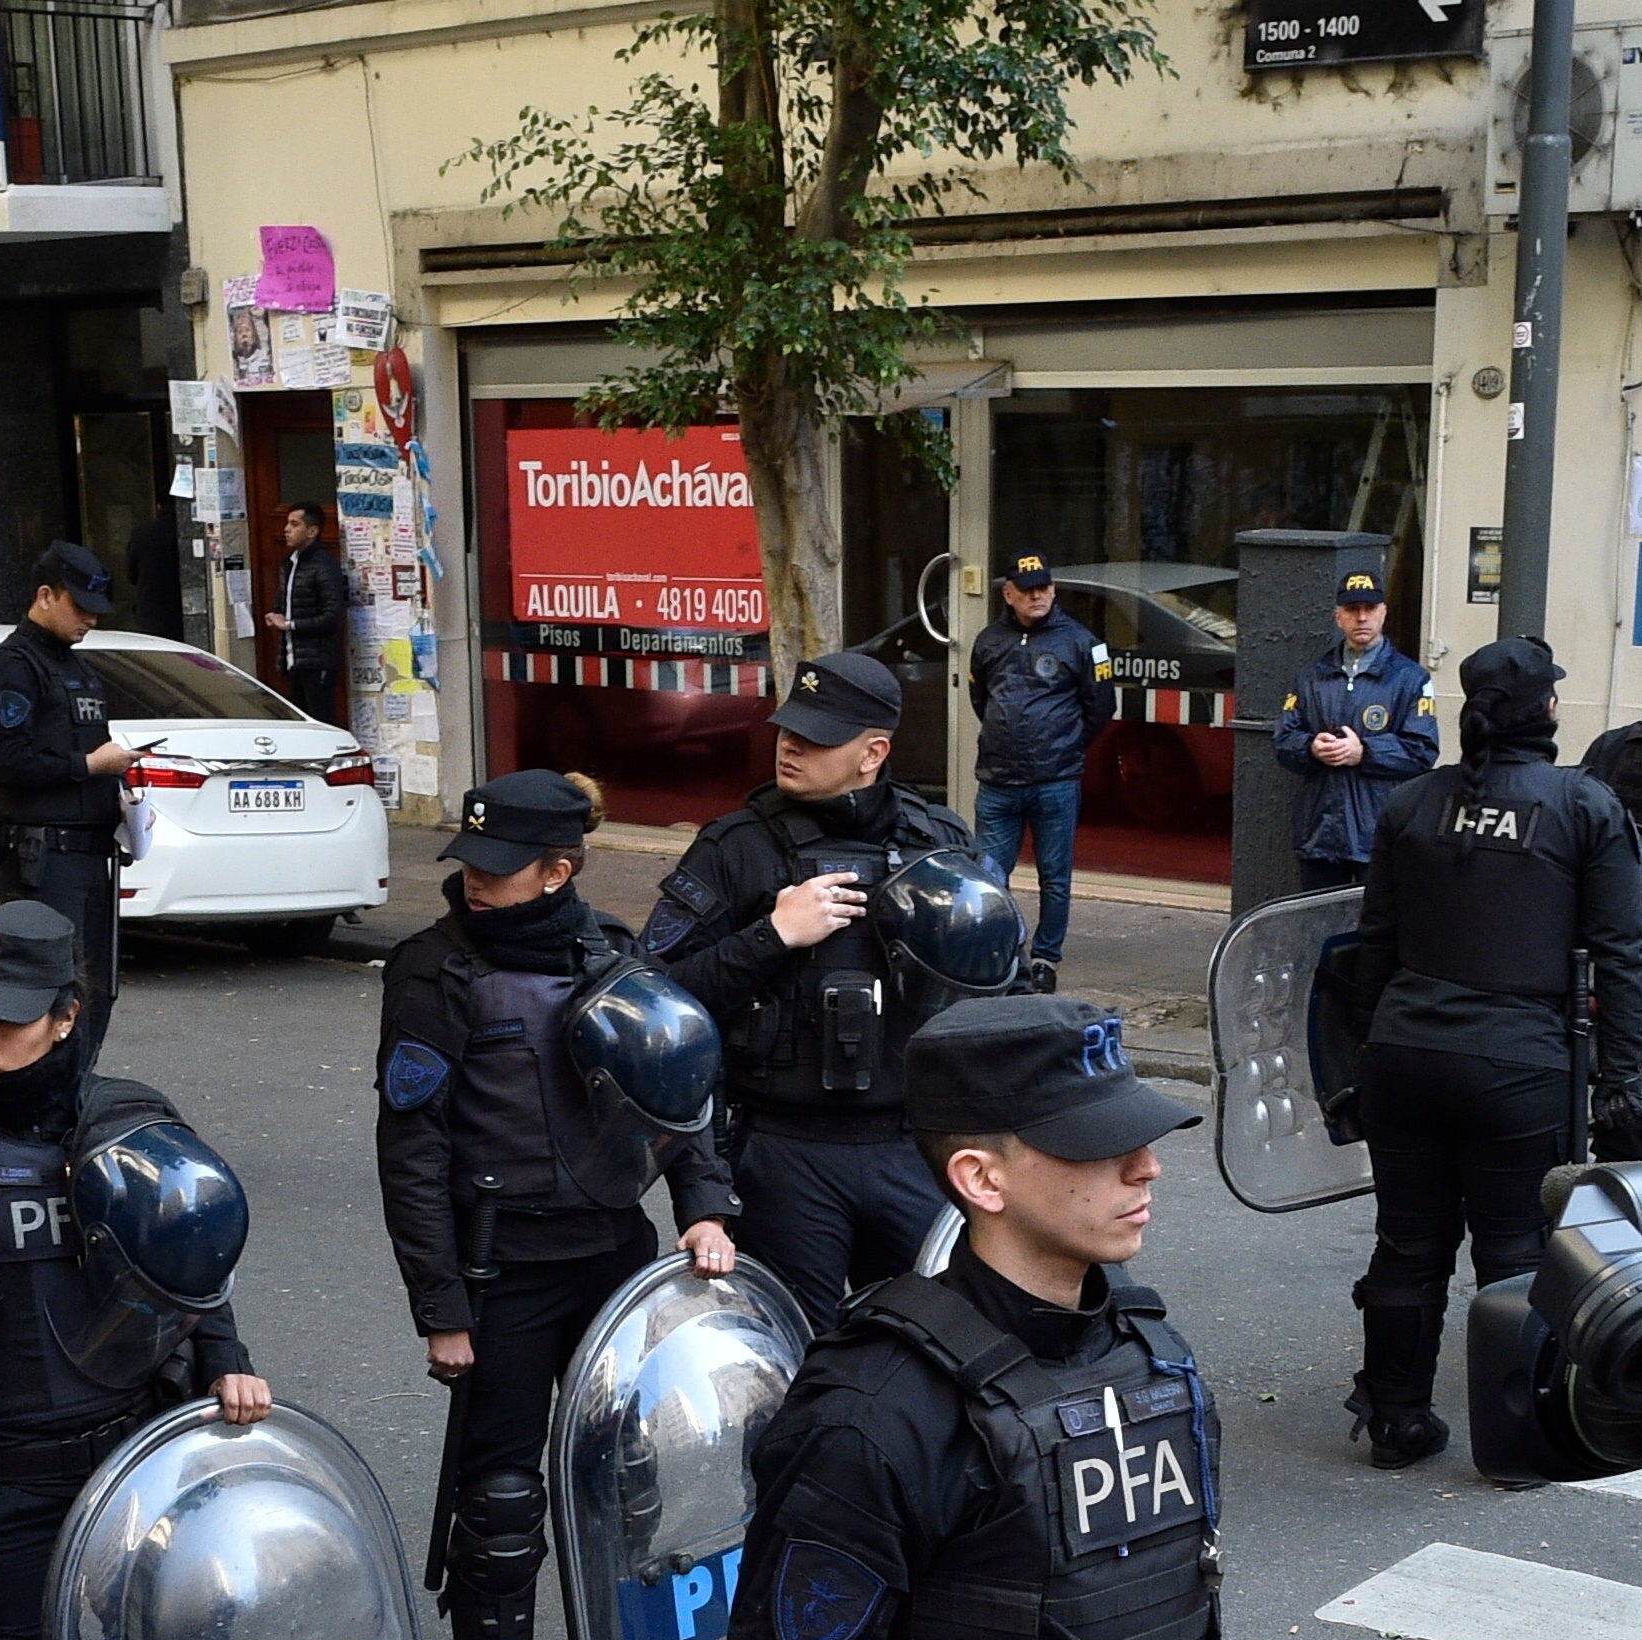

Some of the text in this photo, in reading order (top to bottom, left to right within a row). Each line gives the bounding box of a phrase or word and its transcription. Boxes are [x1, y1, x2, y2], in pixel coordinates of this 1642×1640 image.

[1258, 19, 1300, 42] 1500
[1317, 15, 1360, 38] 1400
[1256, 45, 1317, 64] Comuna 2
[1017, 555, 1044, 573] PFA
[1345, 572, 1375, 591] PFA
[527, 584, 763, 624] ALQUILA 4819 4050
[539, 623, 744, 656] Pisos Departamentos
[233, 790, 302, 809] AA 688 KH
[1072, 1438, 1196, 1535] PFA
